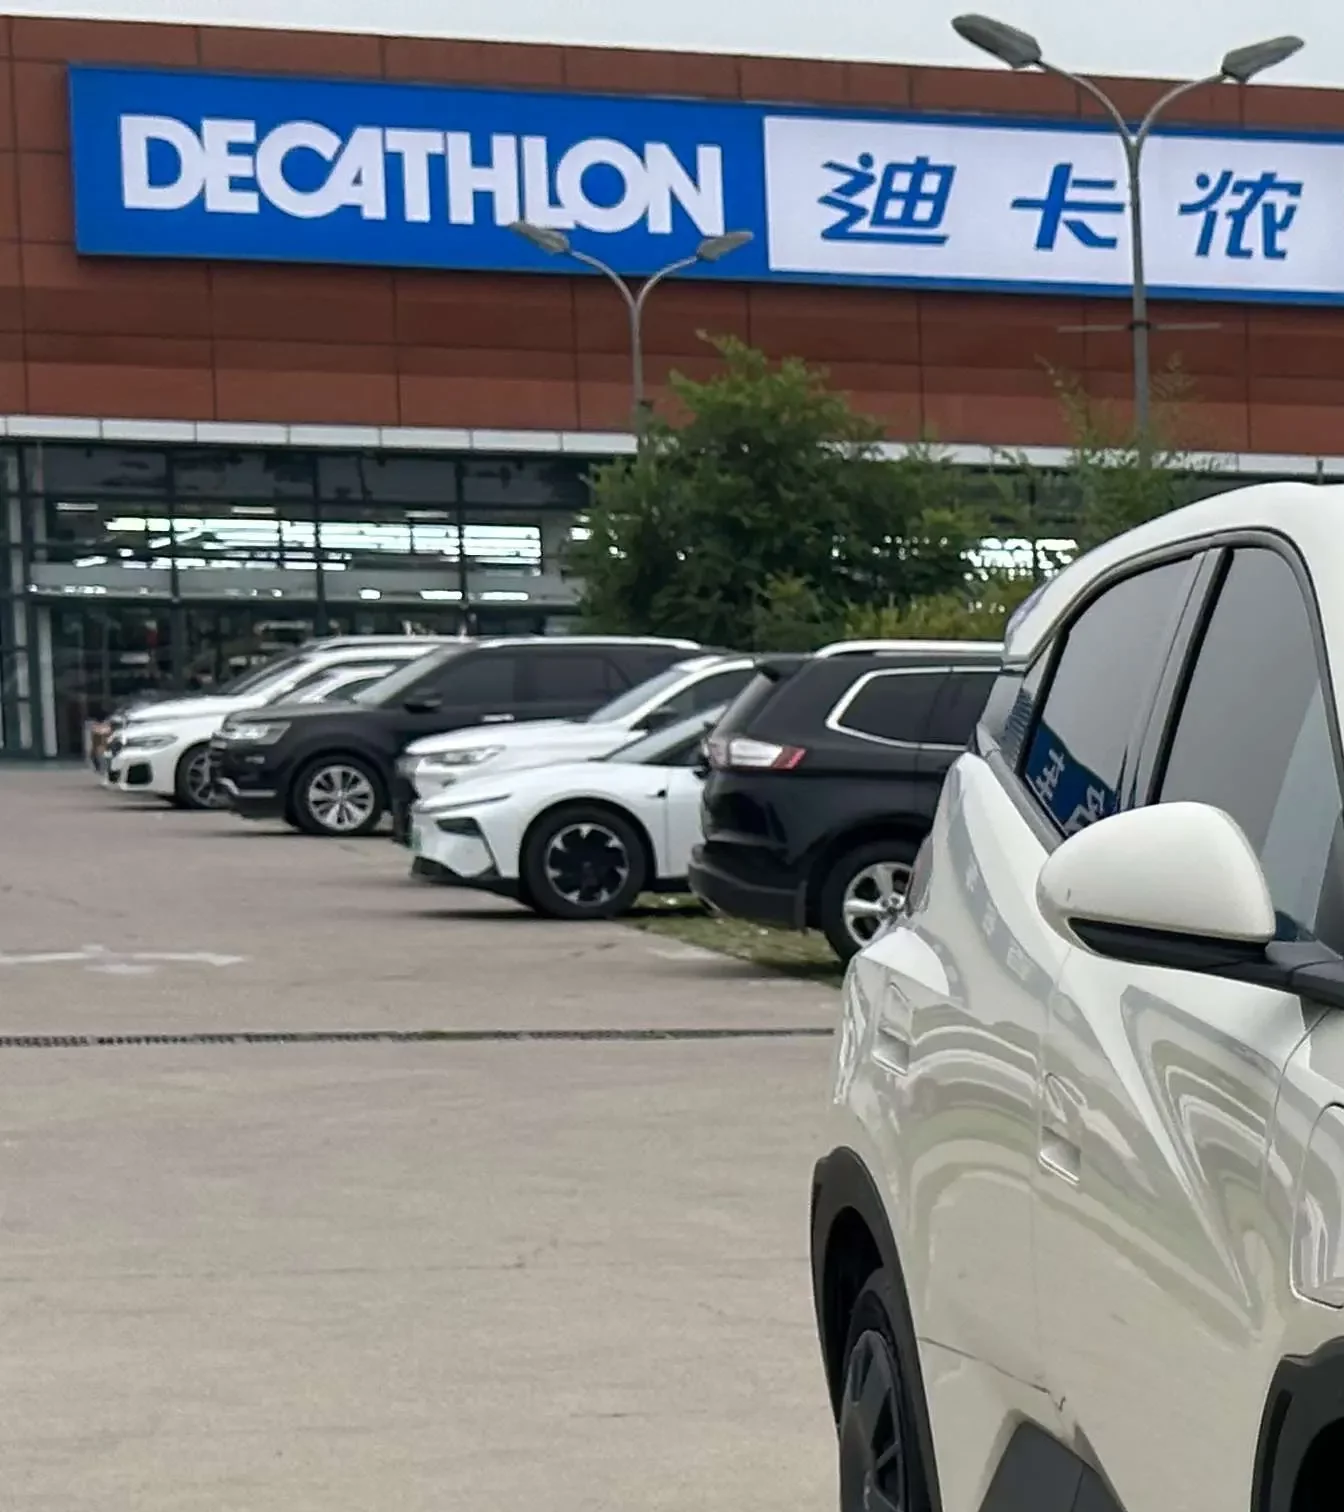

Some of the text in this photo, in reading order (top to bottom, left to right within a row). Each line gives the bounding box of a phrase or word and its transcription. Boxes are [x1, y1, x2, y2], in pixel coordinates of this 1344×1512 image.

[119, 114, 726, 237] DECATHLON
[817, 152, 1304, 260] 迪卡侬
